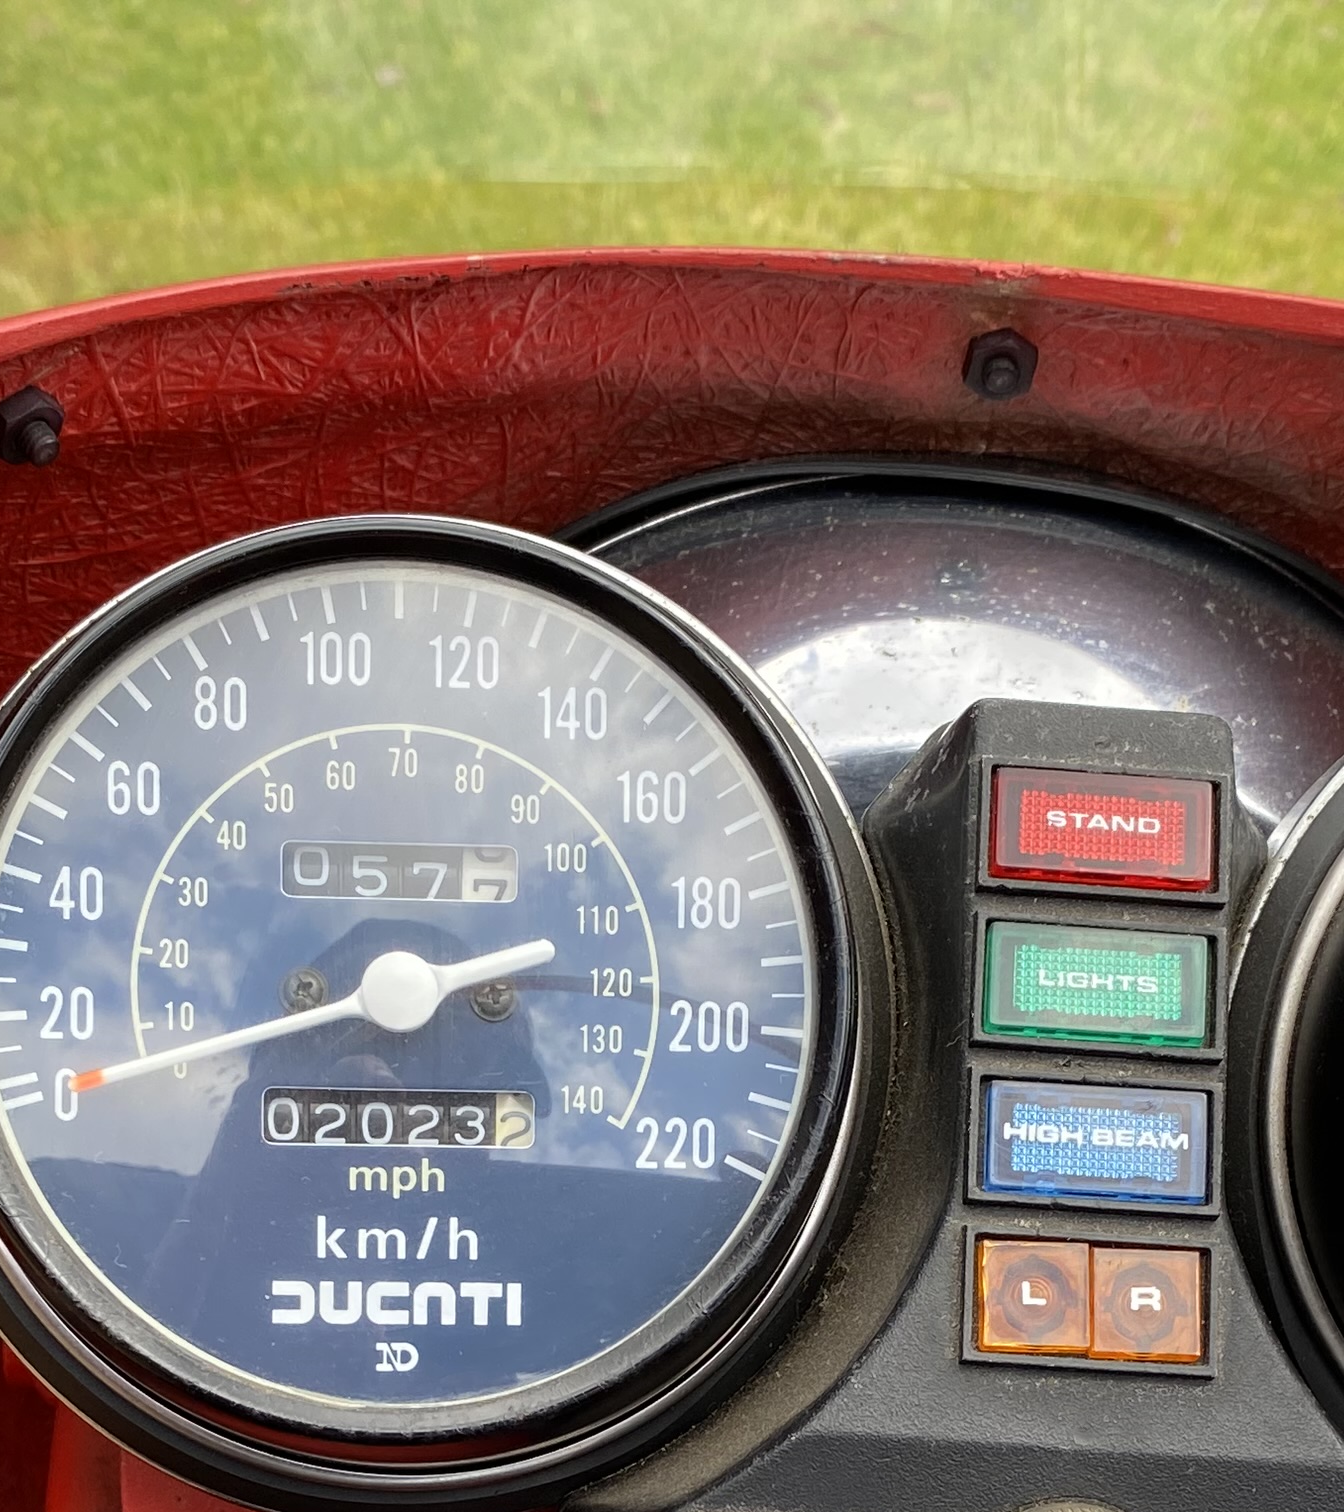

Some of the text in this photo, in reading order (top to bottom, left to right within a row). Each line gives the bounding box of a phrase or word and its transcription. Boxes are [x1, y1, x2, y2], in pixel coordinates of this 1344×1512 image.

[299, 631, 371, 687] 100
[428, 634, 499, 690] 120
[194, 675, 247, 731] 80
[537, 686, 607, 741] 140
[326, 760, 356, 791] 60
[388, 747, 418, 778] 70
[107, 760, 160, 816] 60
[454, 763, 485, 794] 80
[264, 782, 294, 813] 50
[510, 793, 542, 825] 90
[616, 770, 686, 824] 160
[216, 820, 247, 851] 40
[1046, 810, 1161, 834] STAND
[543, 842, 587, 873] 100
[49, 865, 104, 921] 40
[178, 876, 208, 907] 30
[671, 875, 741, 930] 180
[576, 905, 619, 935] 110
[159, 938, 189, 969] 20
[590, 967, 632, 997] 120
[1038, 968, 1159, 993] LIGHTS
[39, 985, 94, 1041] 20
[164, 1001, 195, 1032] 10
[668, 999, 749, 1053] 200
[579, 1024, 623, 1054] 130
[54, 1067, 79, 1122] 0
[561, 1084, 604, 1114] 140
[635, 1116, 715, 1170] 220
[1002, 1120, 1189, 1150] HIGH BEAM
[349, 1157, 445, 1200] mph
[316, 1215, 478, 1261] km/h
[271, 1280, 522, 1326] DUCATI
[1021, 1280, 1047, 1306] L
[1130, 1286, 1161, 1311] R
